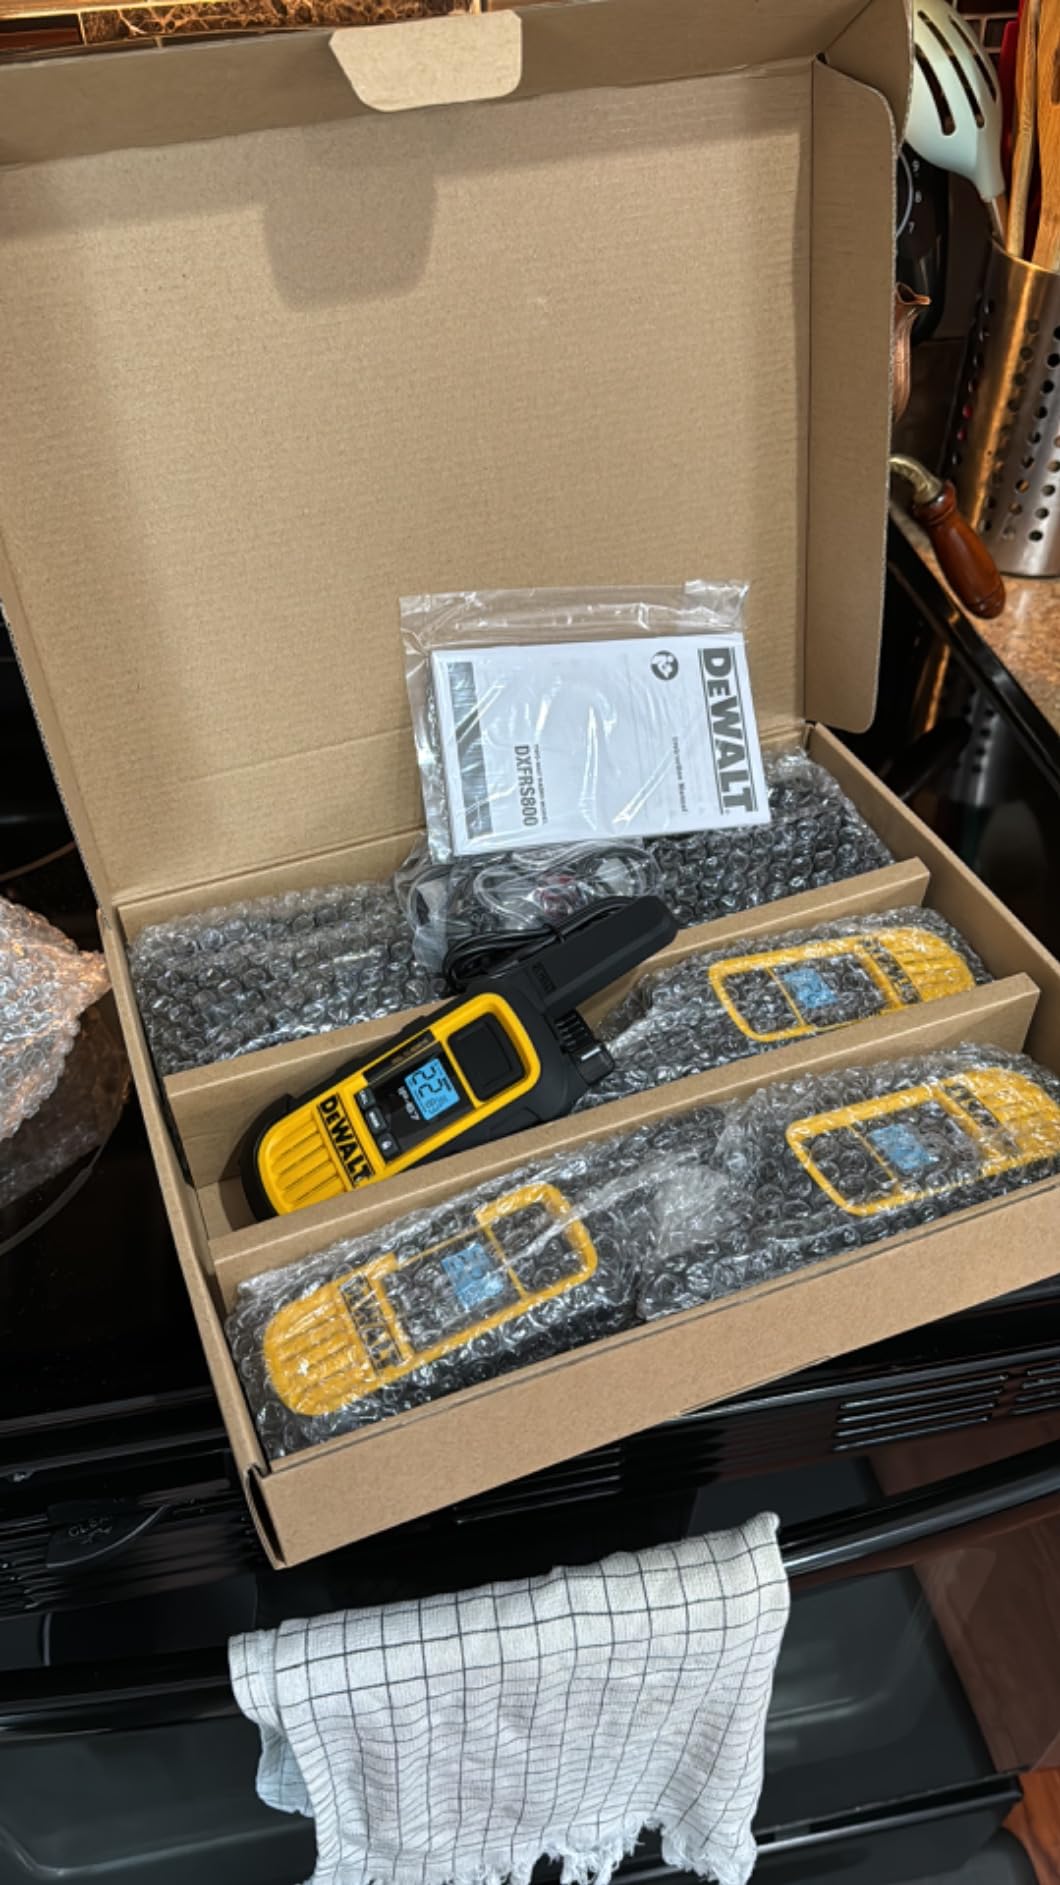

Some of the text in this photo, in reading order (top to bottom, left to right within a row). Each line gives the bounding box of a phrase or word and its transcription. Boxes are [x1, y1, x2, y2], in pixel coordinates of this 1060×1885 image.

[701, 648, 754, 812] DEWALT
[514, 745, 538, 826] DXFRS800
[320, 1095, 372, 1181] DEWALT
